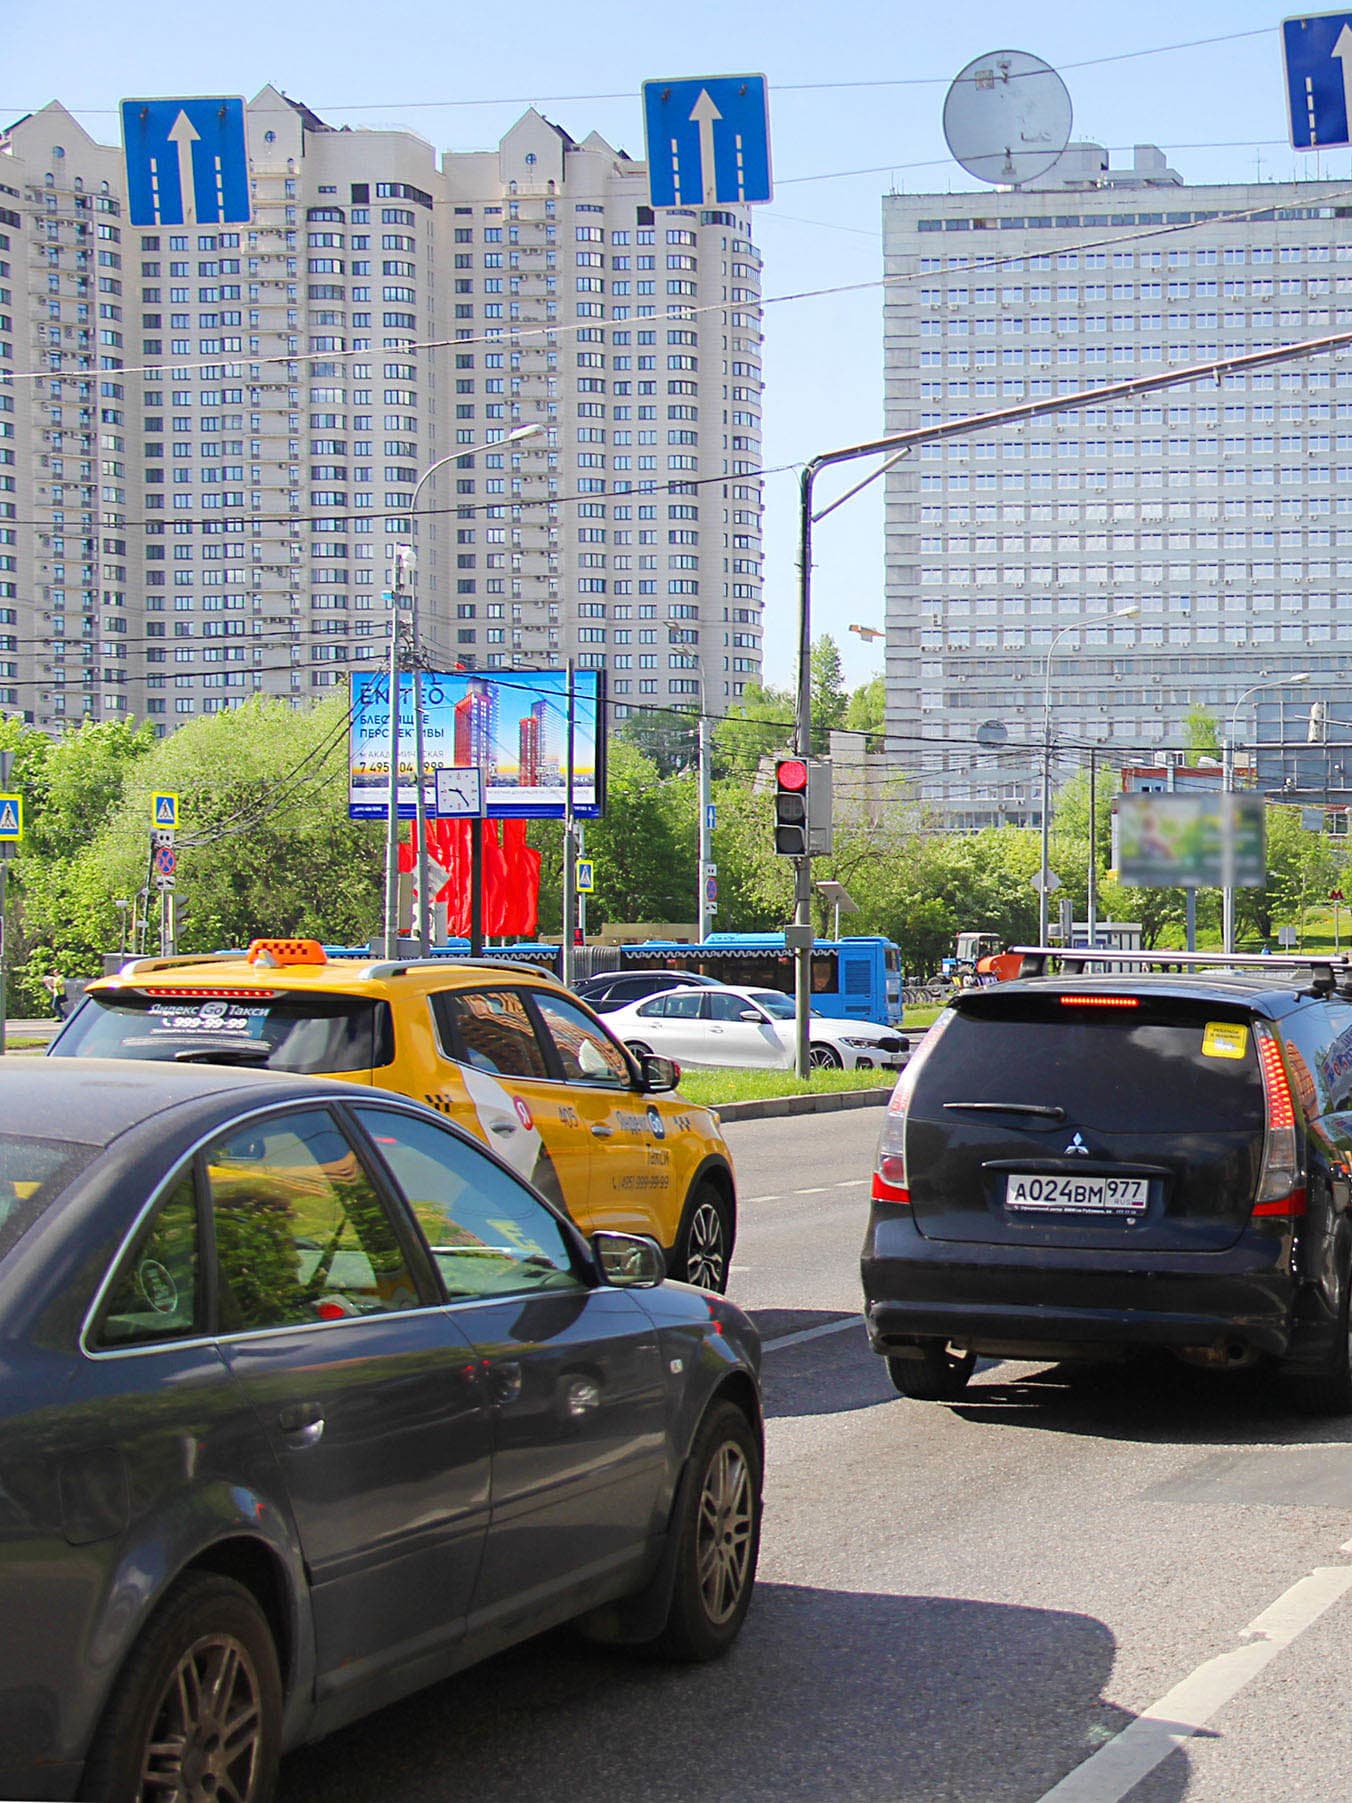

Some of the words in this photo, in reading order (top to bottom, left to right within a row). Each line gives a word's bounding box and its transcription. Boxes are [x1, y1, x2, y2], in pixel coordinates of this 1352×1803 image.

[229, 1004, 269, 1017] Такси
[173, 1017, 248, 1029] 999-99-99
[1015, 1179, 1103, 1203] А024ВМ
[1107, 1181, 1141, 1198] 977
